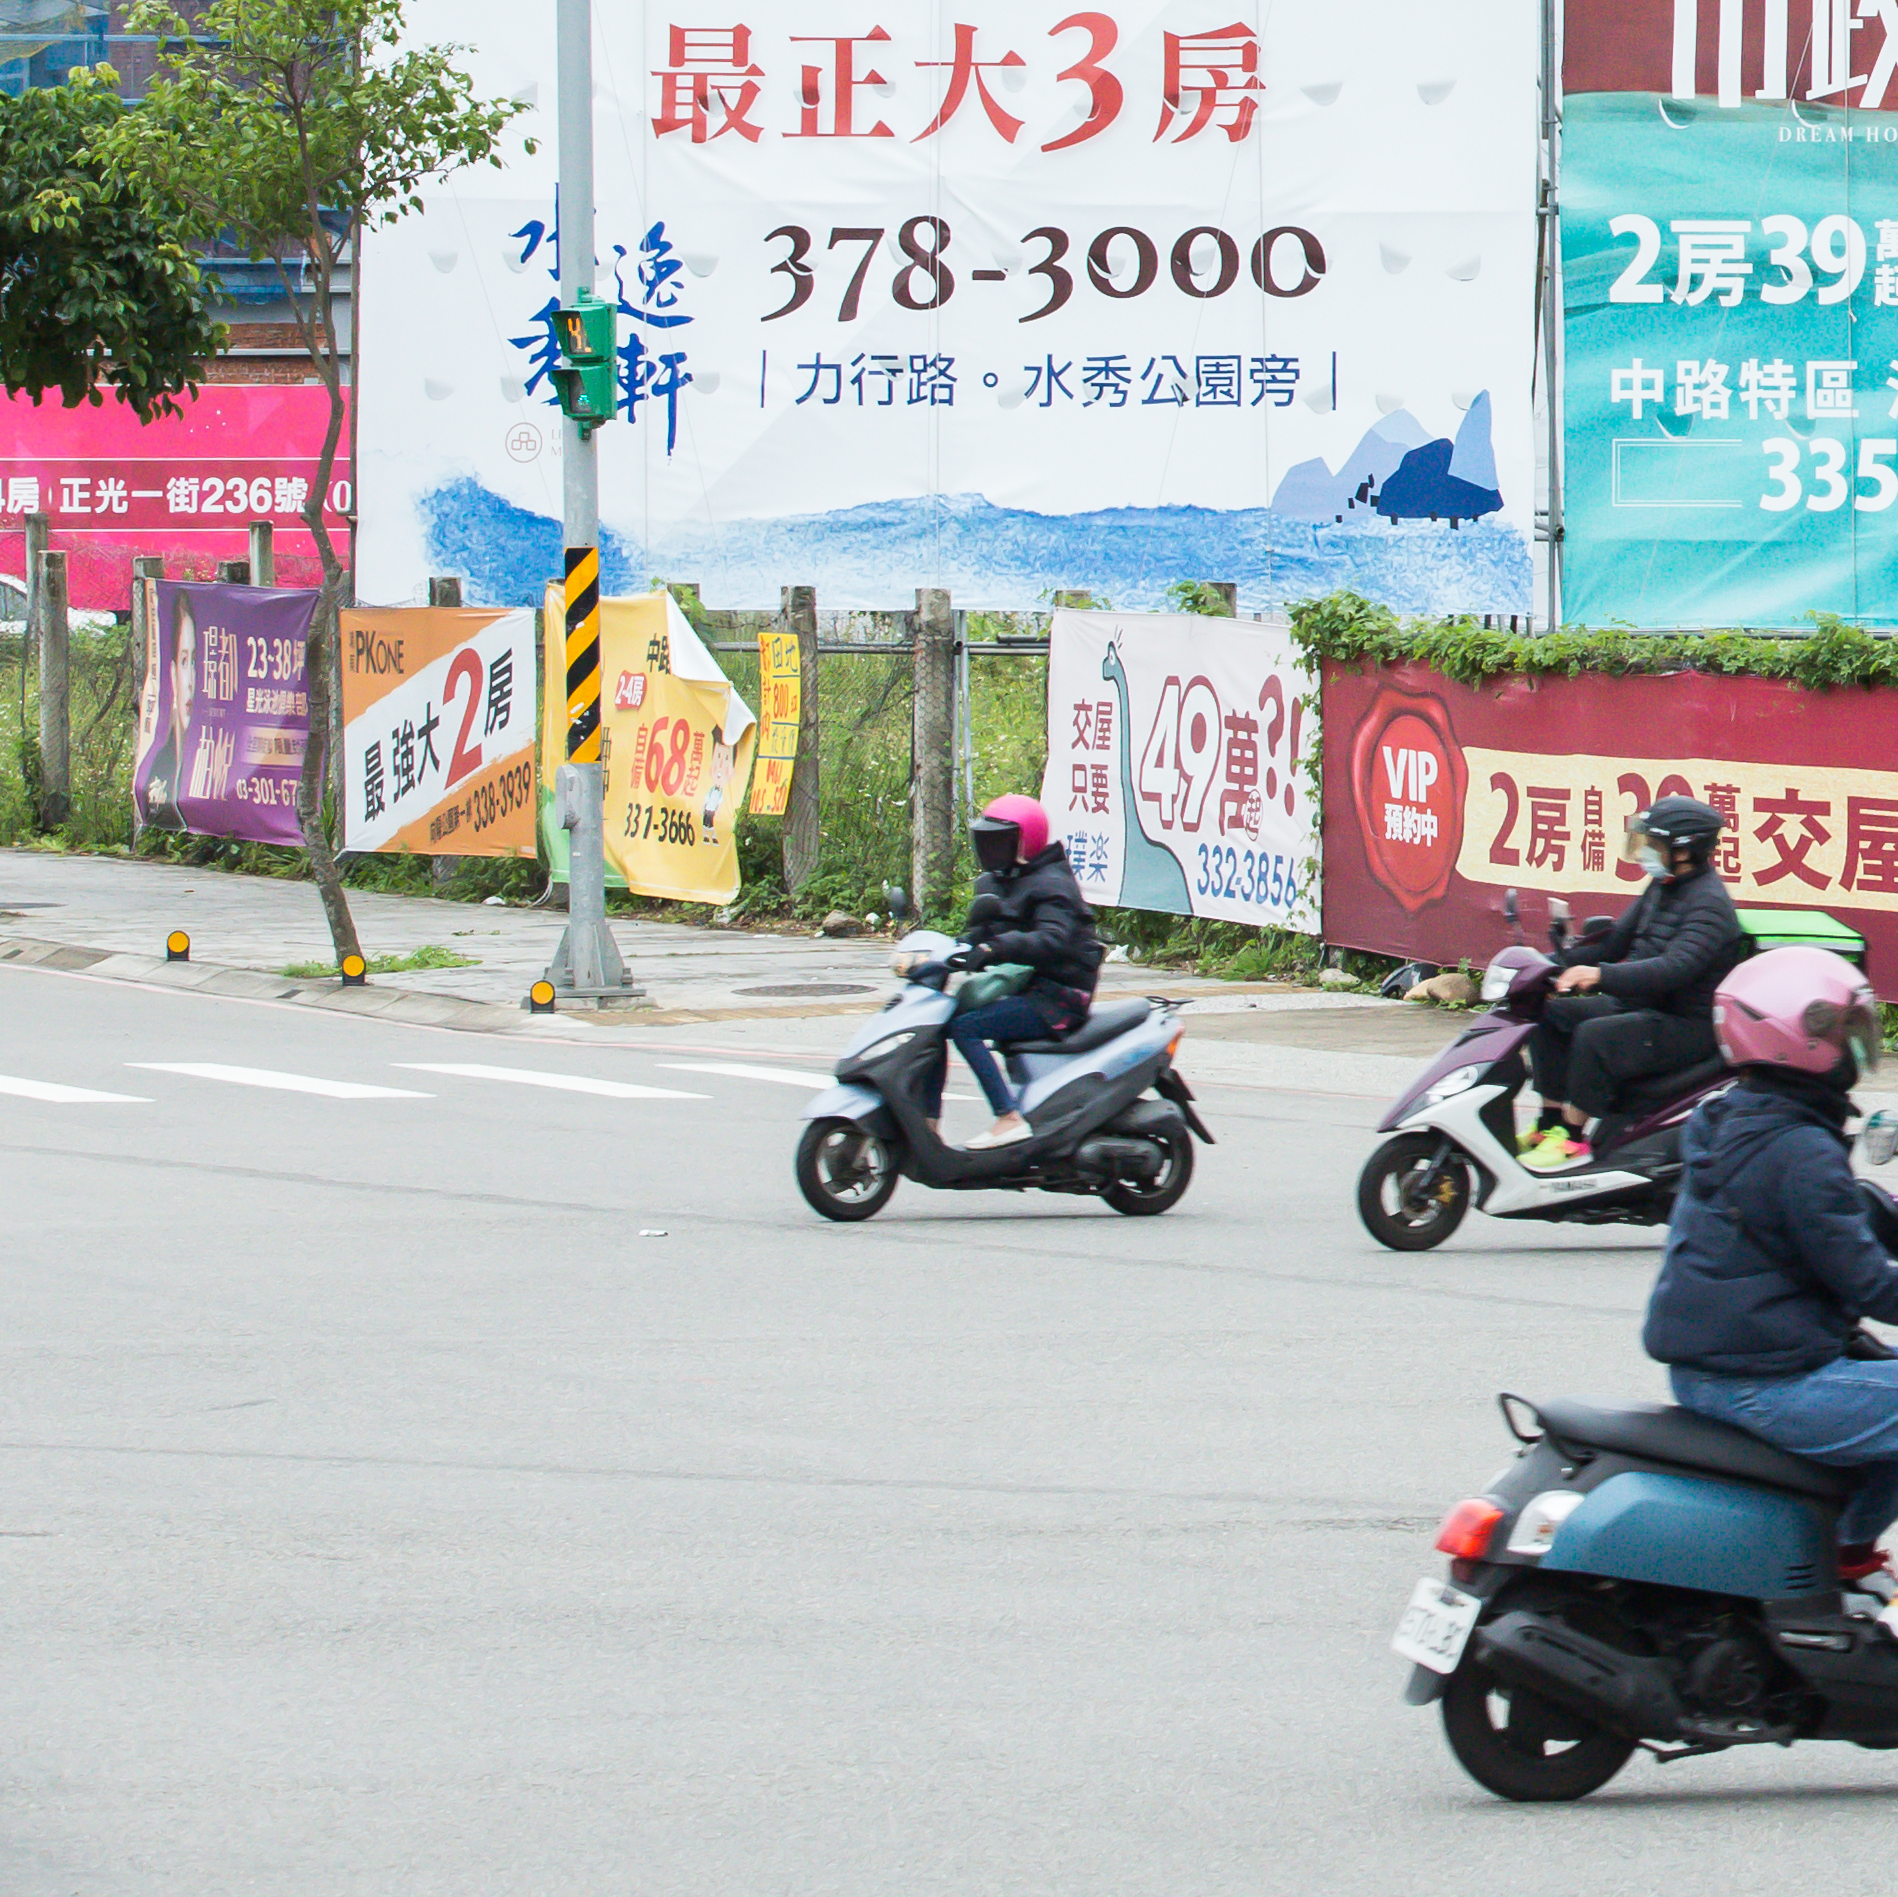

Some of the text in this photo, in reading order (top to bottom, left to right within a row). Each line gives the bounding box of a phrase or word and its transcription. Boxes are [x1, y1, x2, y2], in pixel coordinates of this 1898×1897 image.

[649, 11, 1267, 154] 最正大3房
[1777, 126, 1856, 144] DREAM
[760, 214, 1328, 325] 378-3000
[1609, 357, 1862, 421] 中路特區
[59, 476, 310, 514] 正光一街236號
[355, 630, 404, 674] PKONE
[364, 647, 514, 823] 最強大2房
[1071, 697, 1114, 752] 交屋
[644, 716, 691, 797] 68
[1382, 745, 1439, 804] VIP
[474, 761, 532, 833] 338-3939
[1068, 761, 1111, 816] 只要
[1384, 802, 1439, 848] 預約中
[1197, 842, 1299, 909] 332-3856
